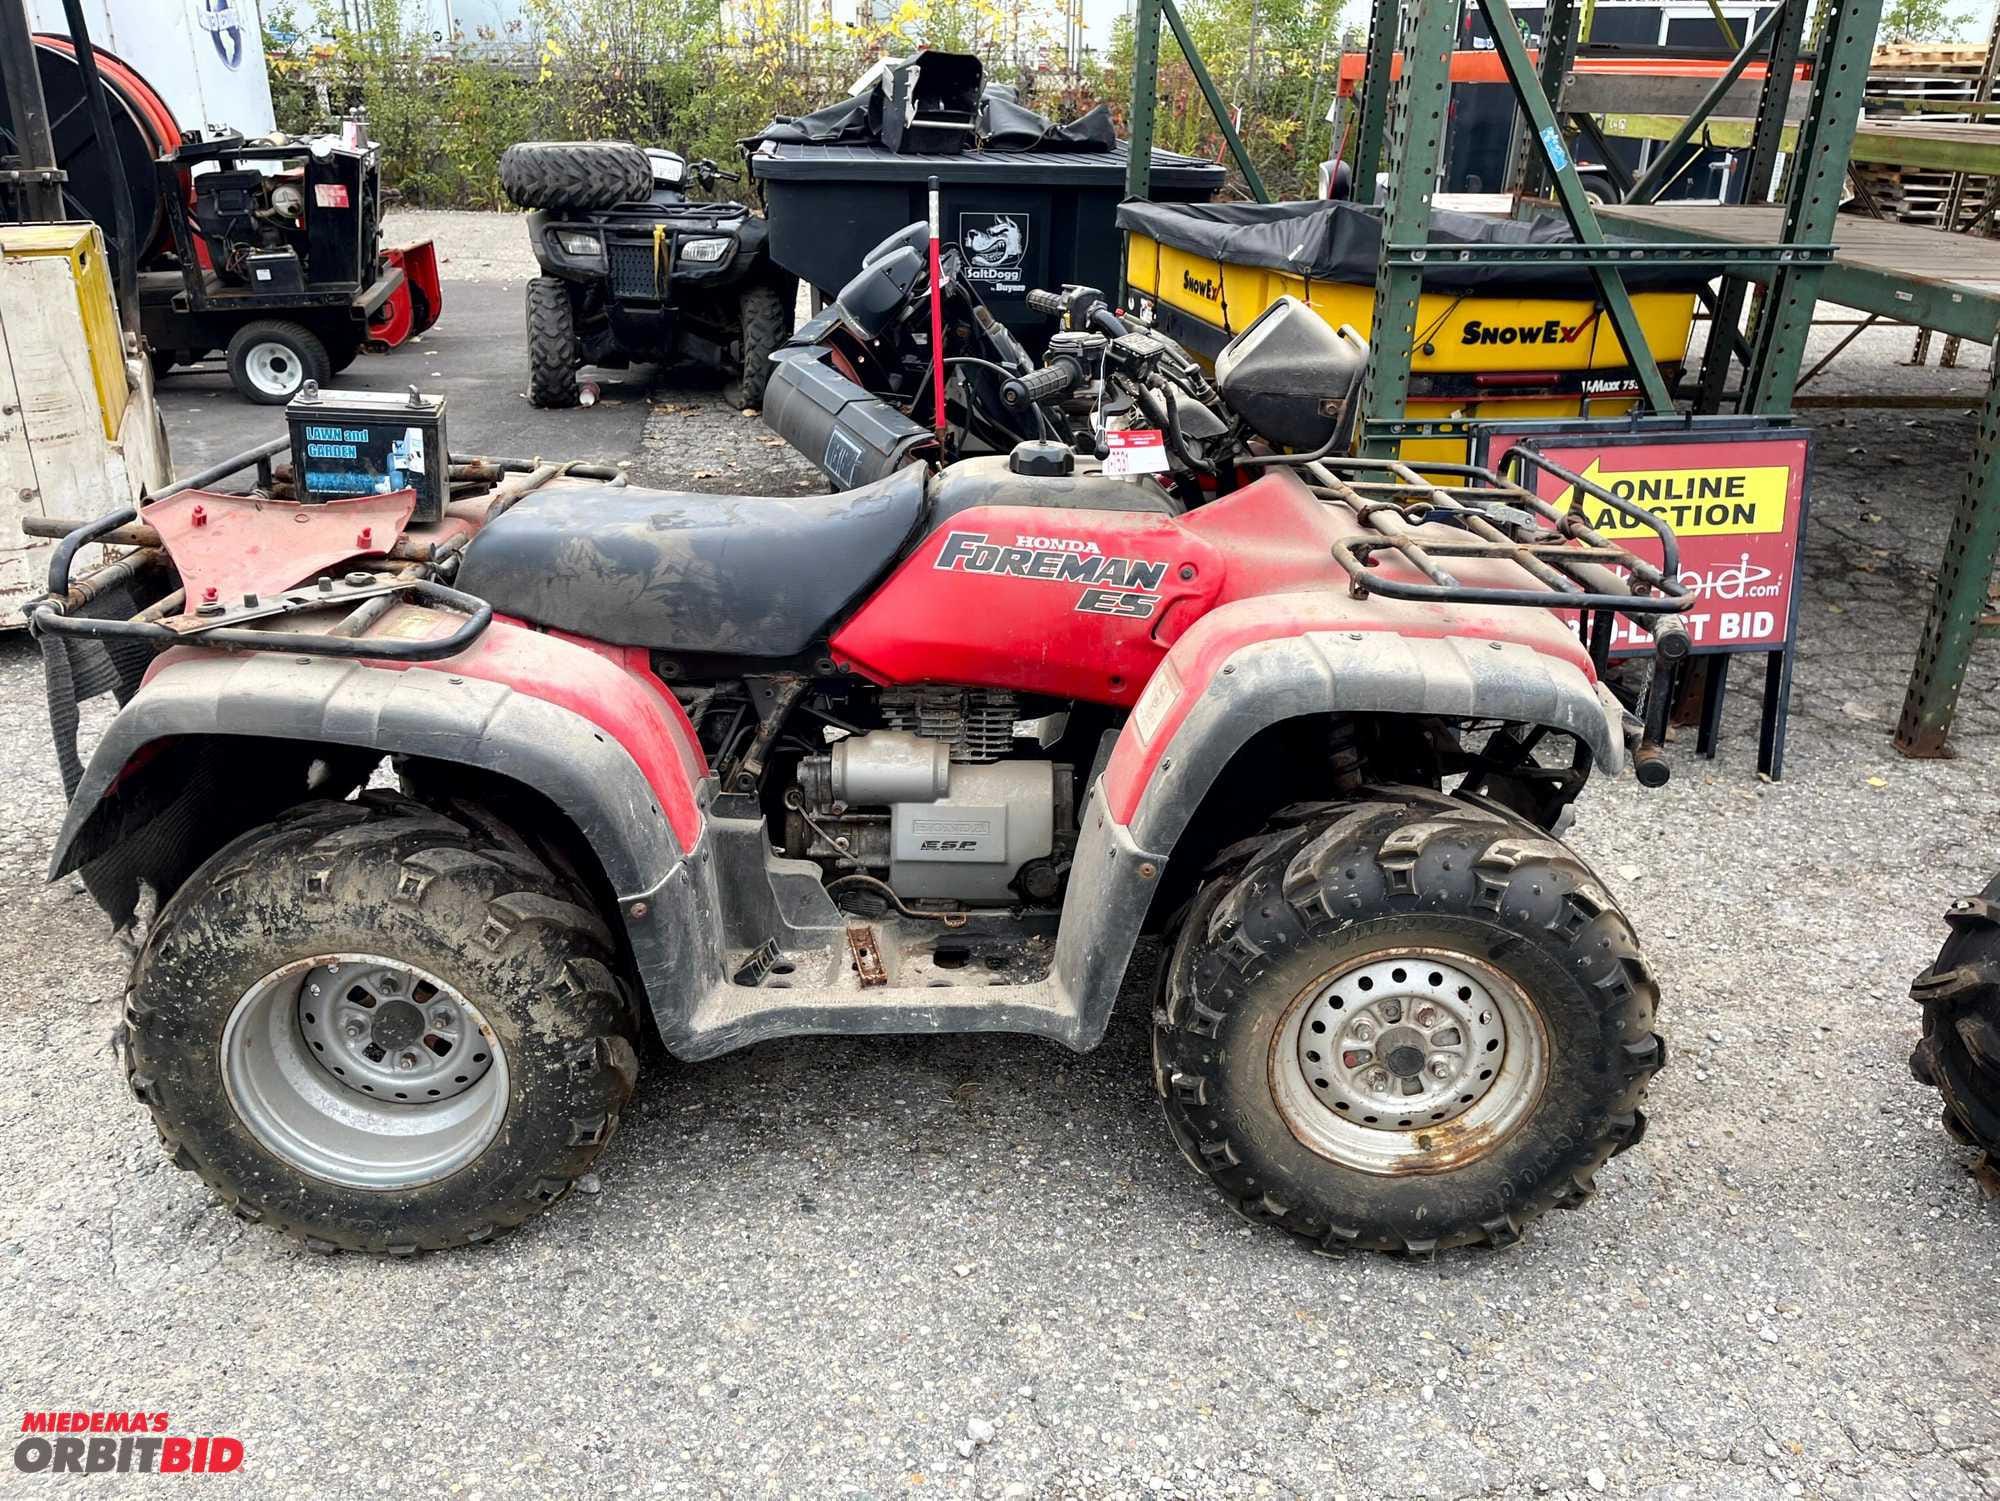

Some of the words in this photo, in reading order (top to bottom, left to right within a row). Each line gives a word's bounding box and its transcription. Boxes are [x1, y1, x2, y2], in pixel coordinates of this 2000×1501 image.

[967, 269, 1019, 281] SaltDogg
[306, 427, 342, 441] LAWN
[343, 429, 369, 442] and
[308, 444, 357, 458] GARDEN
[1611, 476, 1746, 502] ONLINE
[1015, 535, 1099, 554] HONDA
[933, 531, 1169, 591] FOREMAN
[1074, 589, 1161, 619] ES
[1719, 611, 1774, 639] BID
[920, 840, 977, 851] ESP
